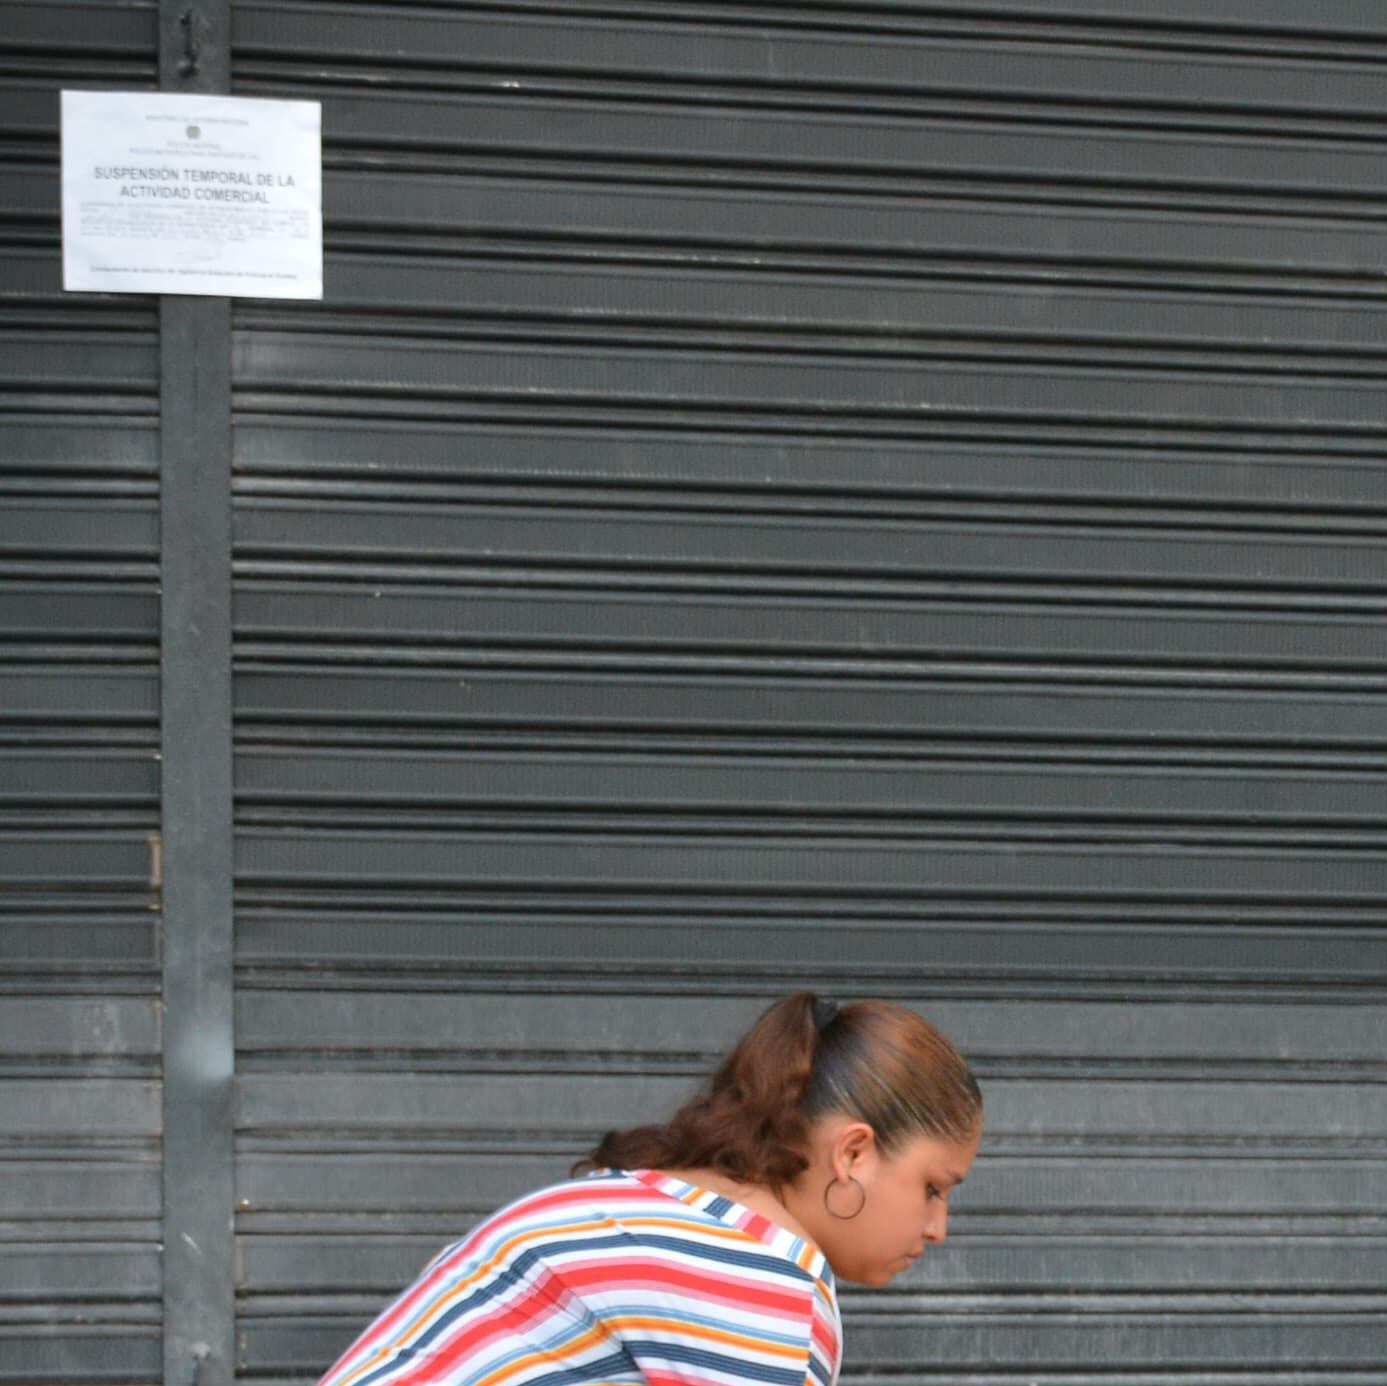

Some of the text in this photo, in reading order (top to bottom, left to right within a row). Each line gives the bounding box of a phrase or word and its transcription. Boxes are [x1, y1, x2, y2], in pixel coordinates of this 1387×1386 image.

[93, 165, 295, 188] SUSPENSIÓN TEMPORAL DE LA
[120, 185, 270, 204] ACTIVIDAD COMERCIAL
